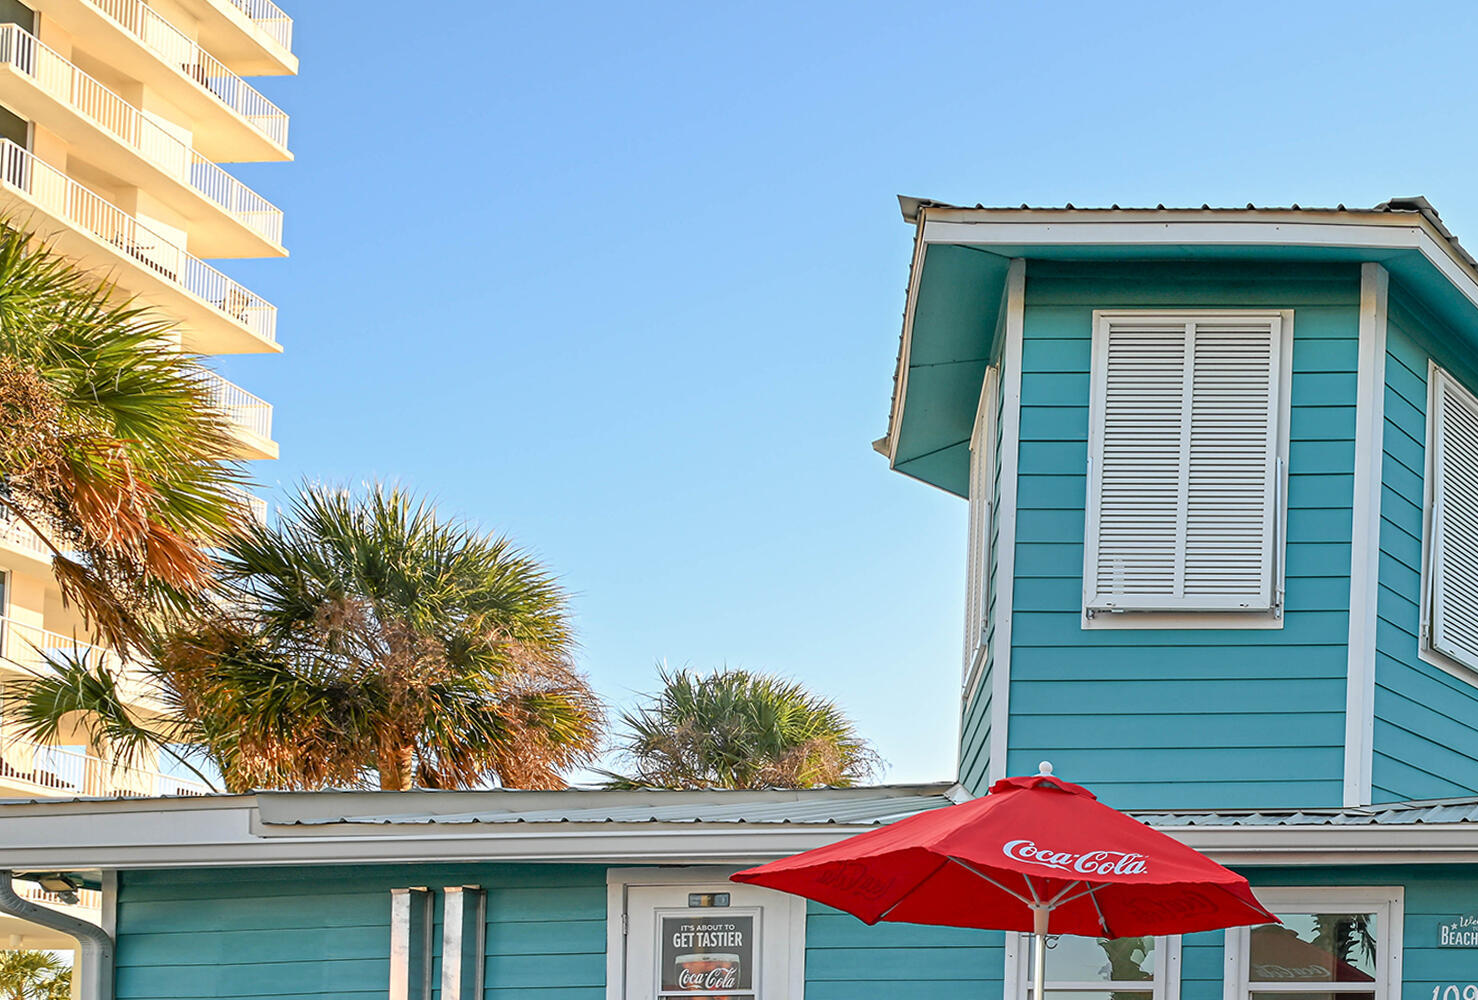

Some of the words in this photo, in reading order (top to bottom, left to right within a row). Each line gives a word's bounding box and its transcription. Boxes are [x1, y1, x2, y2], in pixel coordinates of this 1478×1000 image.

[1002, 839, 1149, 875] Coca-Cola
[673, 932, 695, 948] GET
[696, 931, 743, 947] TASTIER
[1441, 925, 1478, 946] BEACH
[678, 967, 738, 989] Coca-Cola
